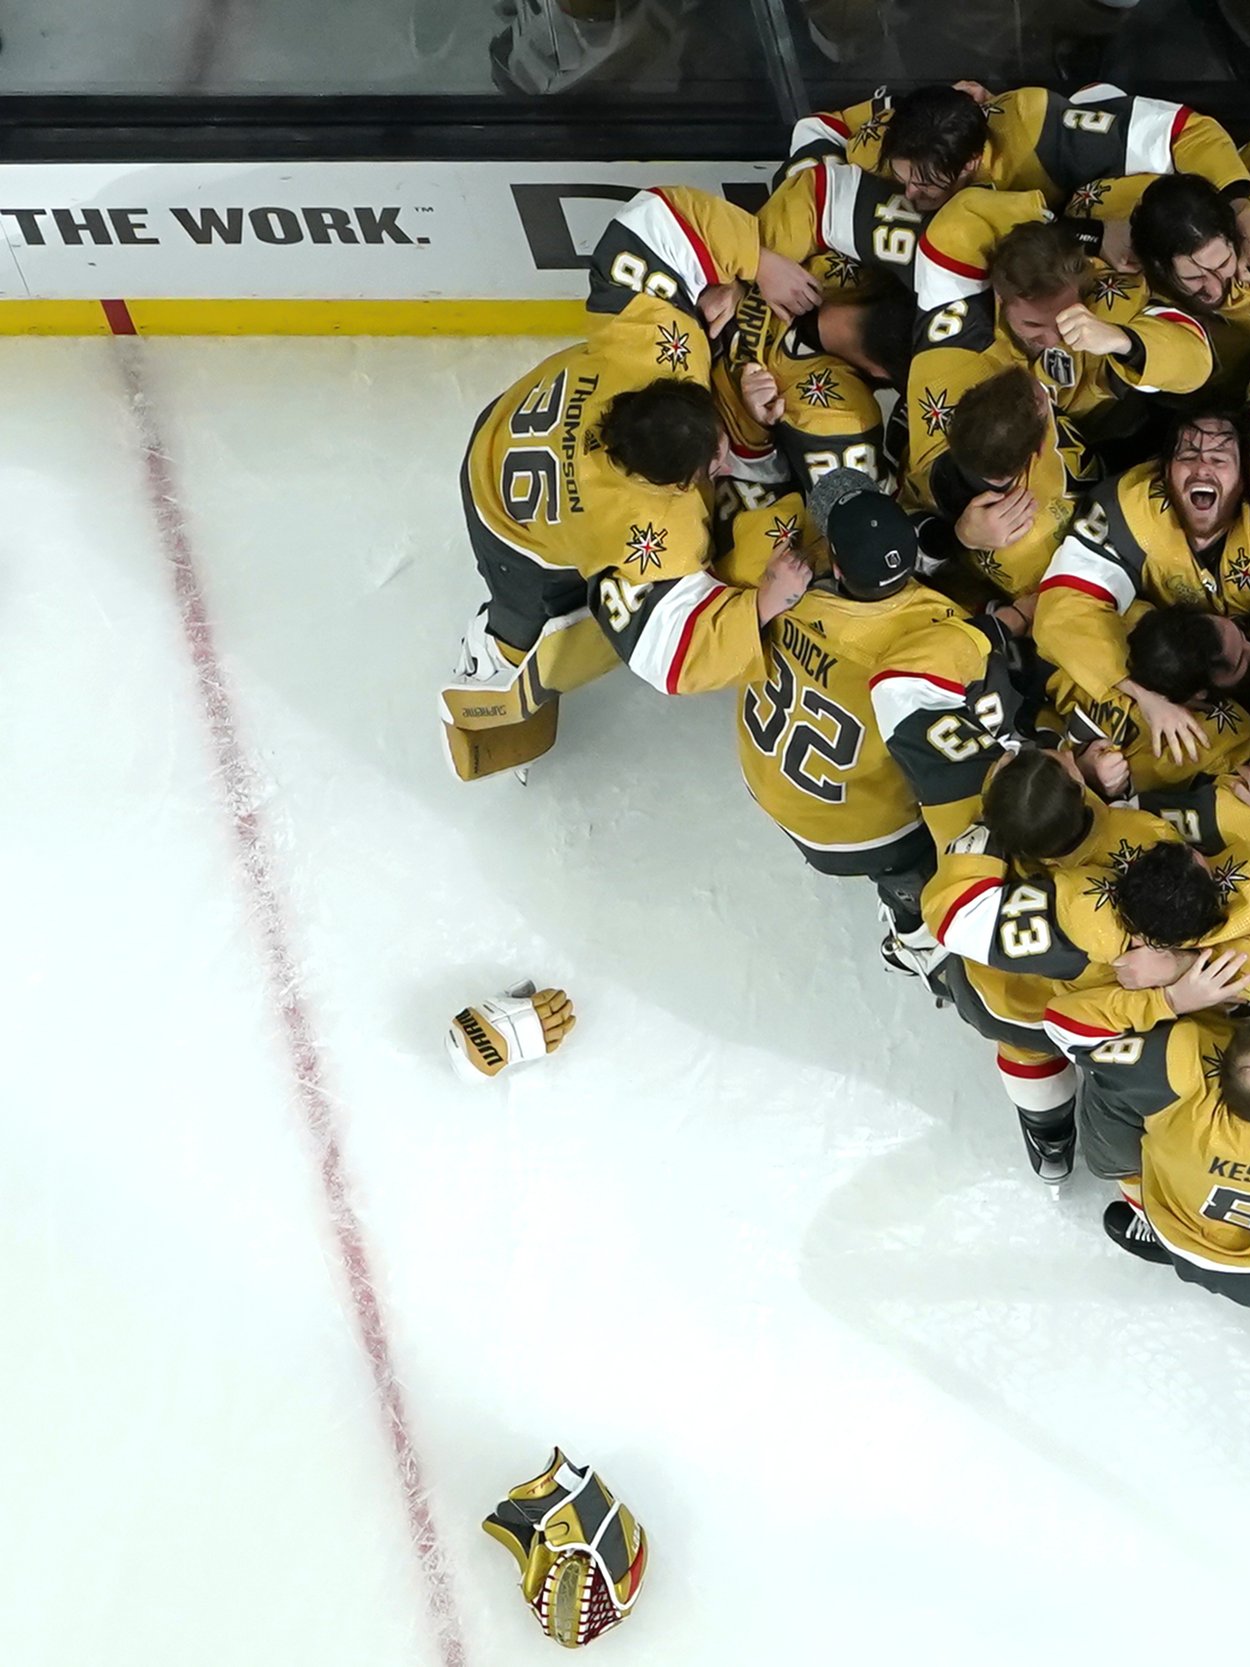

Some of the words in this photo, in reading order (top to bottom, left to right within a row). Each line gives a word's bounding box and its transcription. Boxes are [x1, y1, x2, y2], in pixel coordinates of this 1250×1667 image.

[0, 207, 160, 245] THE
[169, 206, 431, 245] WORK.
[500, 367, 569, 526] 36
[561, 373, 600, 514] THOMPSON
[782, 617, 838, 689] QUICK
[743, 640, 866, 804] 32
[1000, 884, 1052, 959] 43
